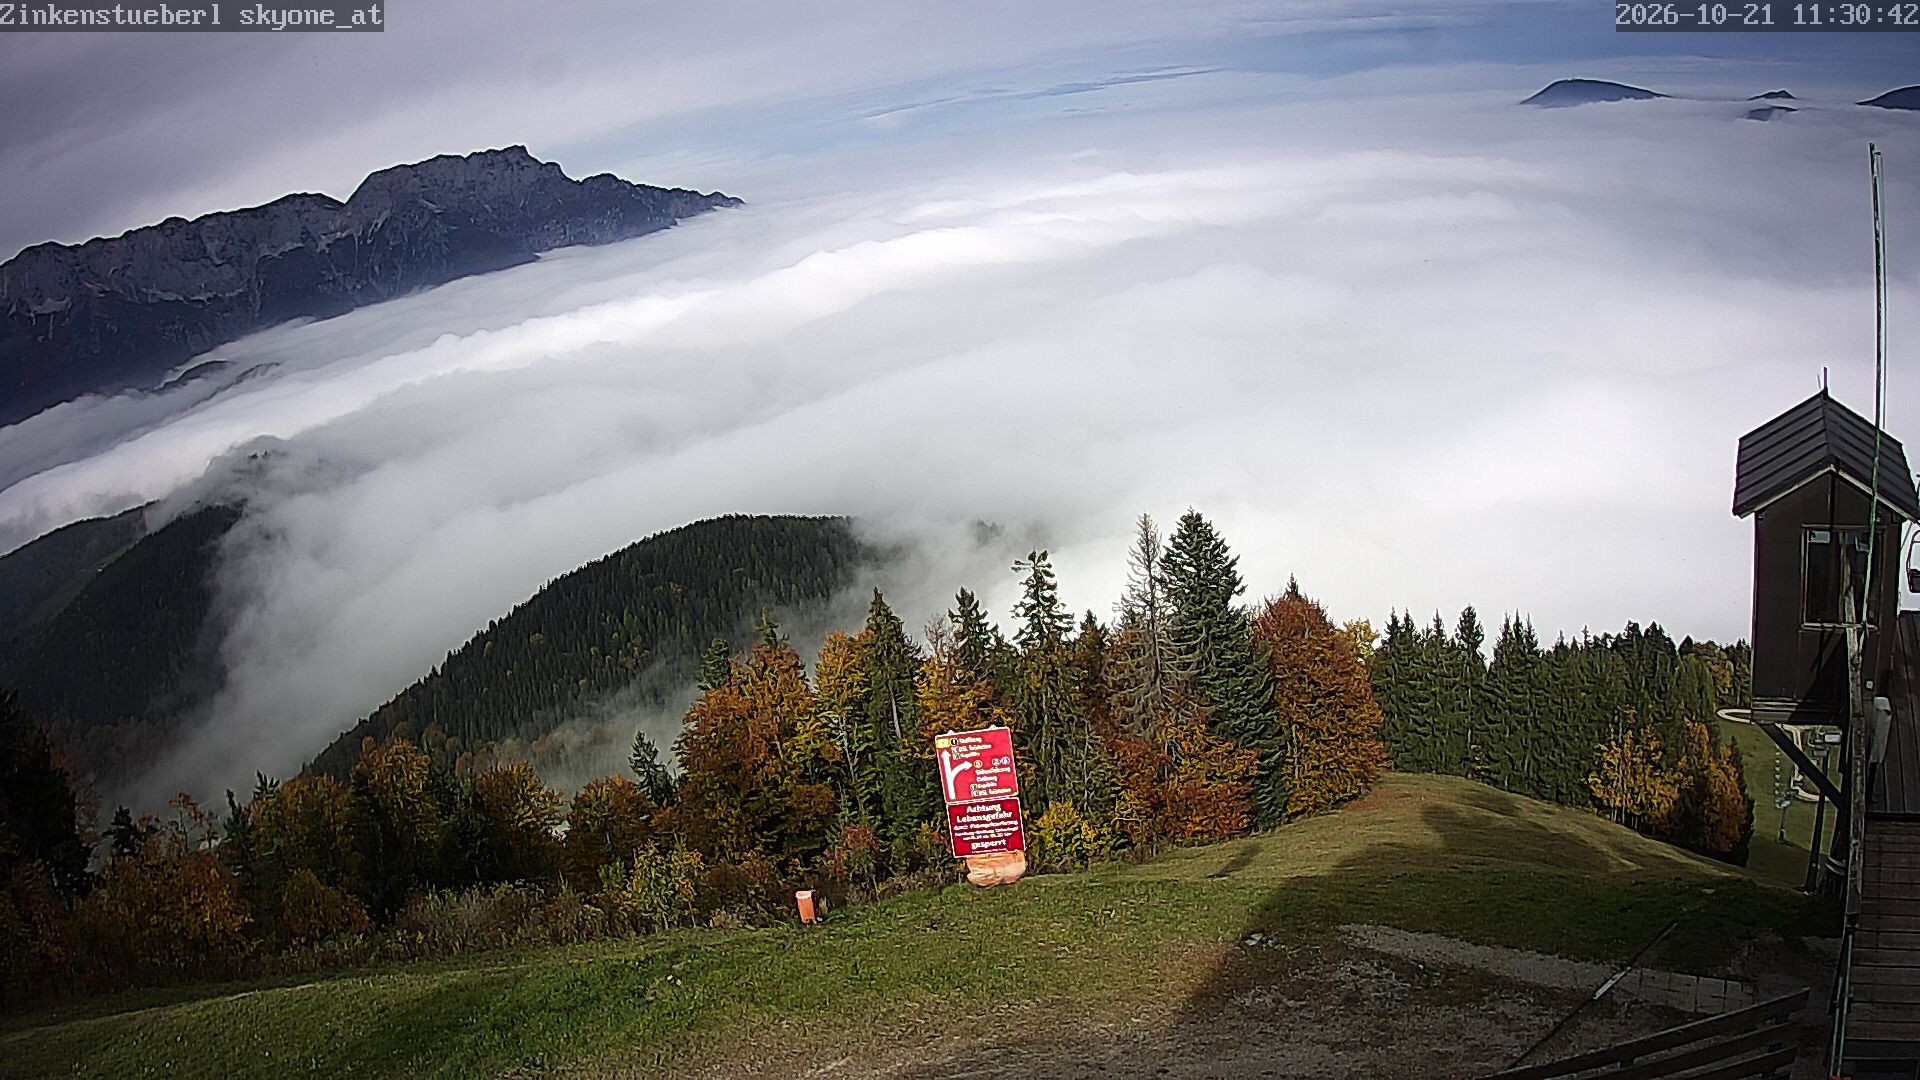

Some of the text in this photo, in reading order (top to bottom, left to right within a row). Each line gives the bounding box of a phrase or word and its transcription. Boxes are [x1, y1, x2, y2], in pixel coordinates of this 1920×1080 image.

[966, 804, 1001, 813] Achtung
[956, 811, 1013, 823] Lebensgefahr
[971, 839, 1007, 850] gesperrt
